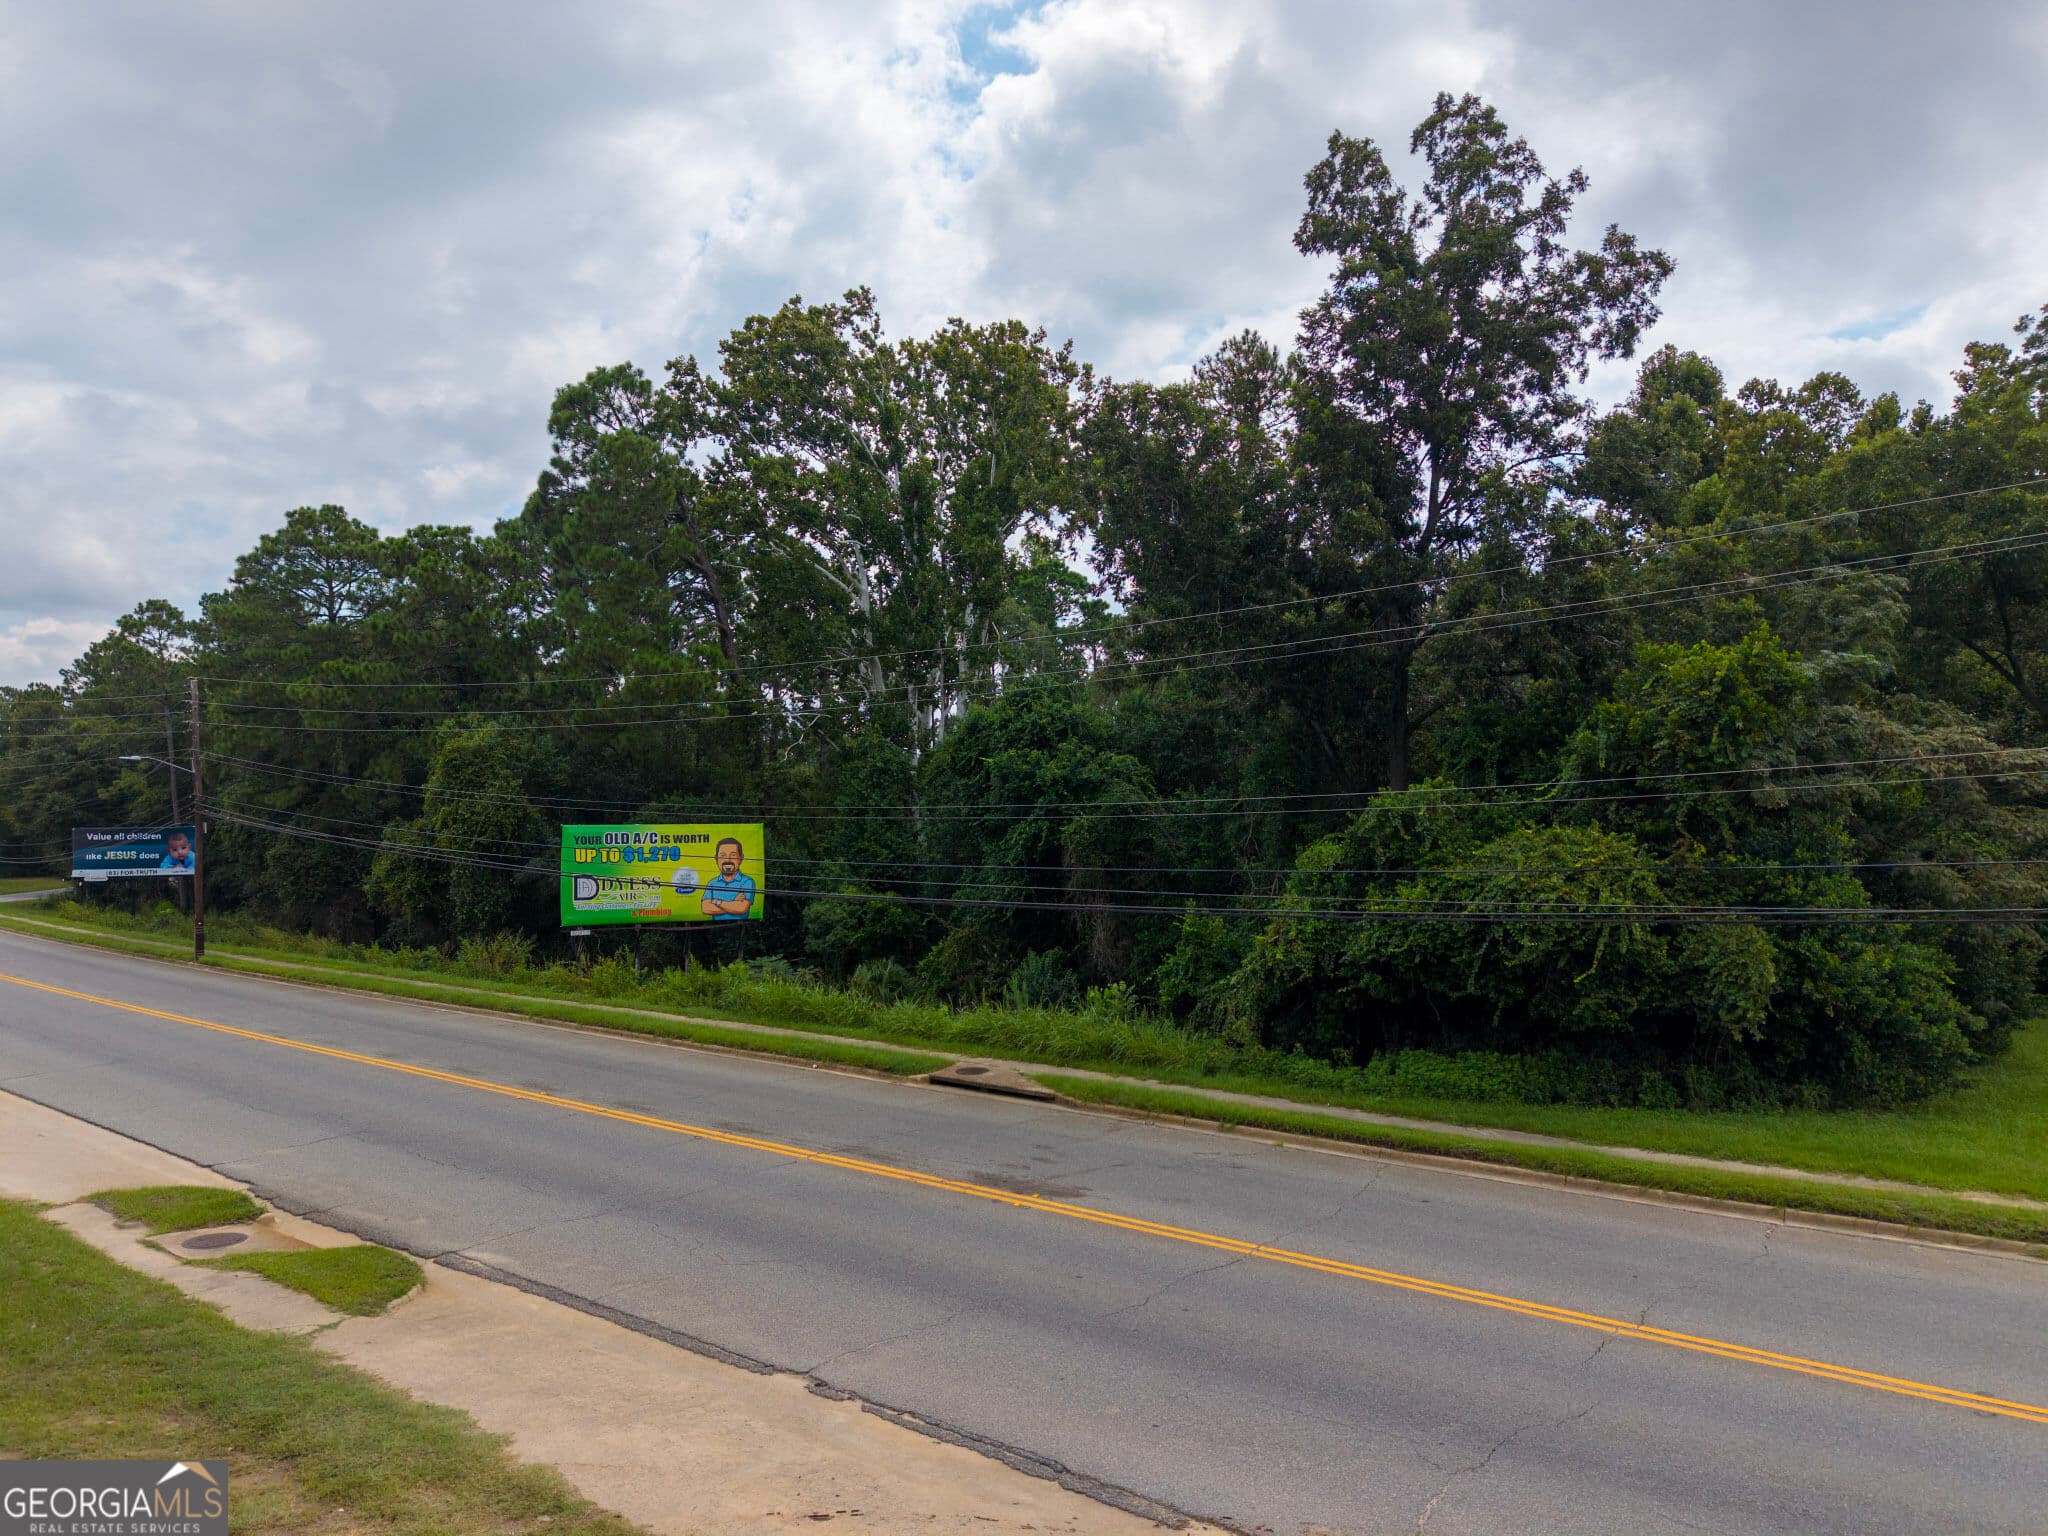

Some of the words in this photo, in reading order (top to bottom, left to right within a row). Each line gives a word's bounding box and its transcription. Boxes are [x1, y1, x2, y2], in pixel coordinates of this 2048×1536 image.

[86, 833, 111, 841] Value
[114, 833, 124, 841] all
[127, 832, 161, 841] children
[574, 835, 602, 846] YOUR
[604, 832, 630, 846] OLD
[633, 832, 658, 845] A/C
[660, 834, 671, 844] IS
[673, 834, 710, 844] WORTH
[86, 853, 102, 861] like
[104, 851, 137, 860] JESUS
[139, 852, 160, 860] does
[574, 847, 597, 863] UP
[599, 847, 620, 863] TO
[623, 846, 681, 863] $1,270
[602, 876, 661, 891] DYESS
[617, 892, 638, 901] AIR
